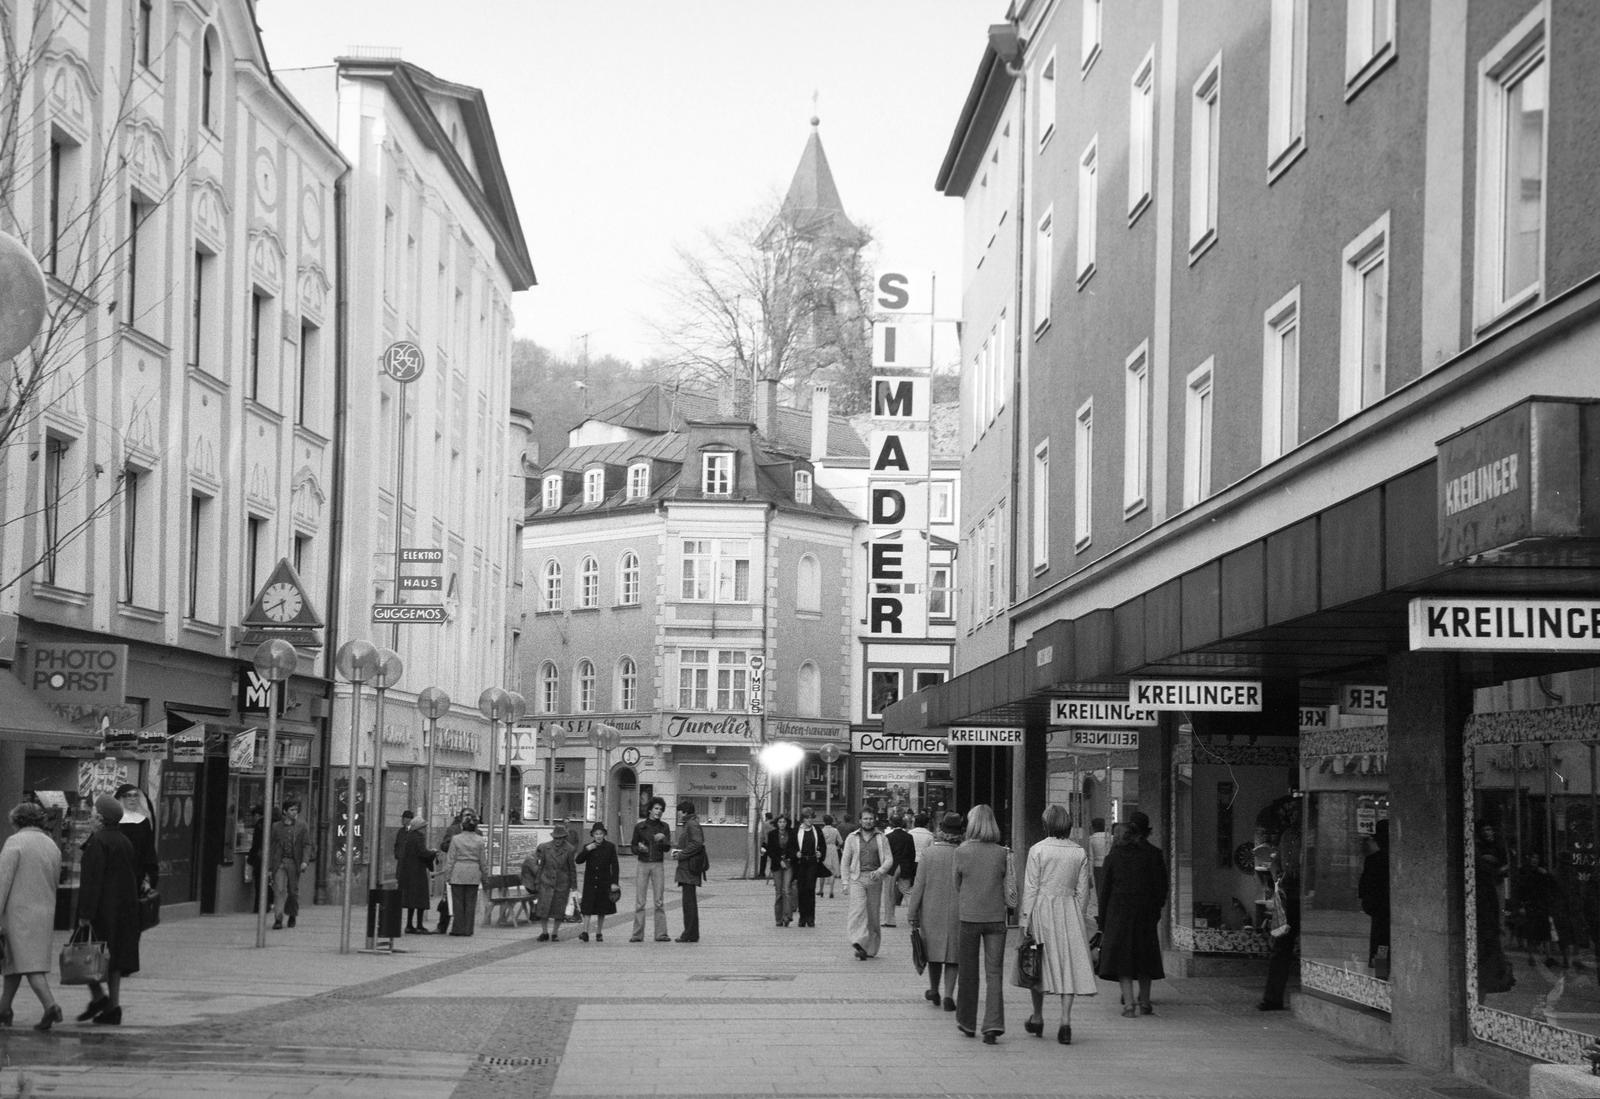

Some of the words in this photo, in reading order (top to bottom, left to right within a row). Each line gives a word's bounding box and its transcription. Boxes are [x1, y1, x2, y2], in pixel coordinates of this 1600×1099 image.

[870, 272, 914, 635] SIMADER
[1445, 453, 1519, 517] KREILINGER
[402, 551, 442, 561] ELEKTRO
[402, 579, 438, 588] HAUS
[374, 608, 442, 619] GUGGEMOS
[34, 649, 117, 669] PHOTO
[33, 671, 115, 692] PORST
[751, 670, 762, 714] IMBISS
[1137, 685, 1259, 705] KREILINGER
[1056, 703, 1156, 721] KREILINGER
[951, 730, 1022, 743] KREILINGER
